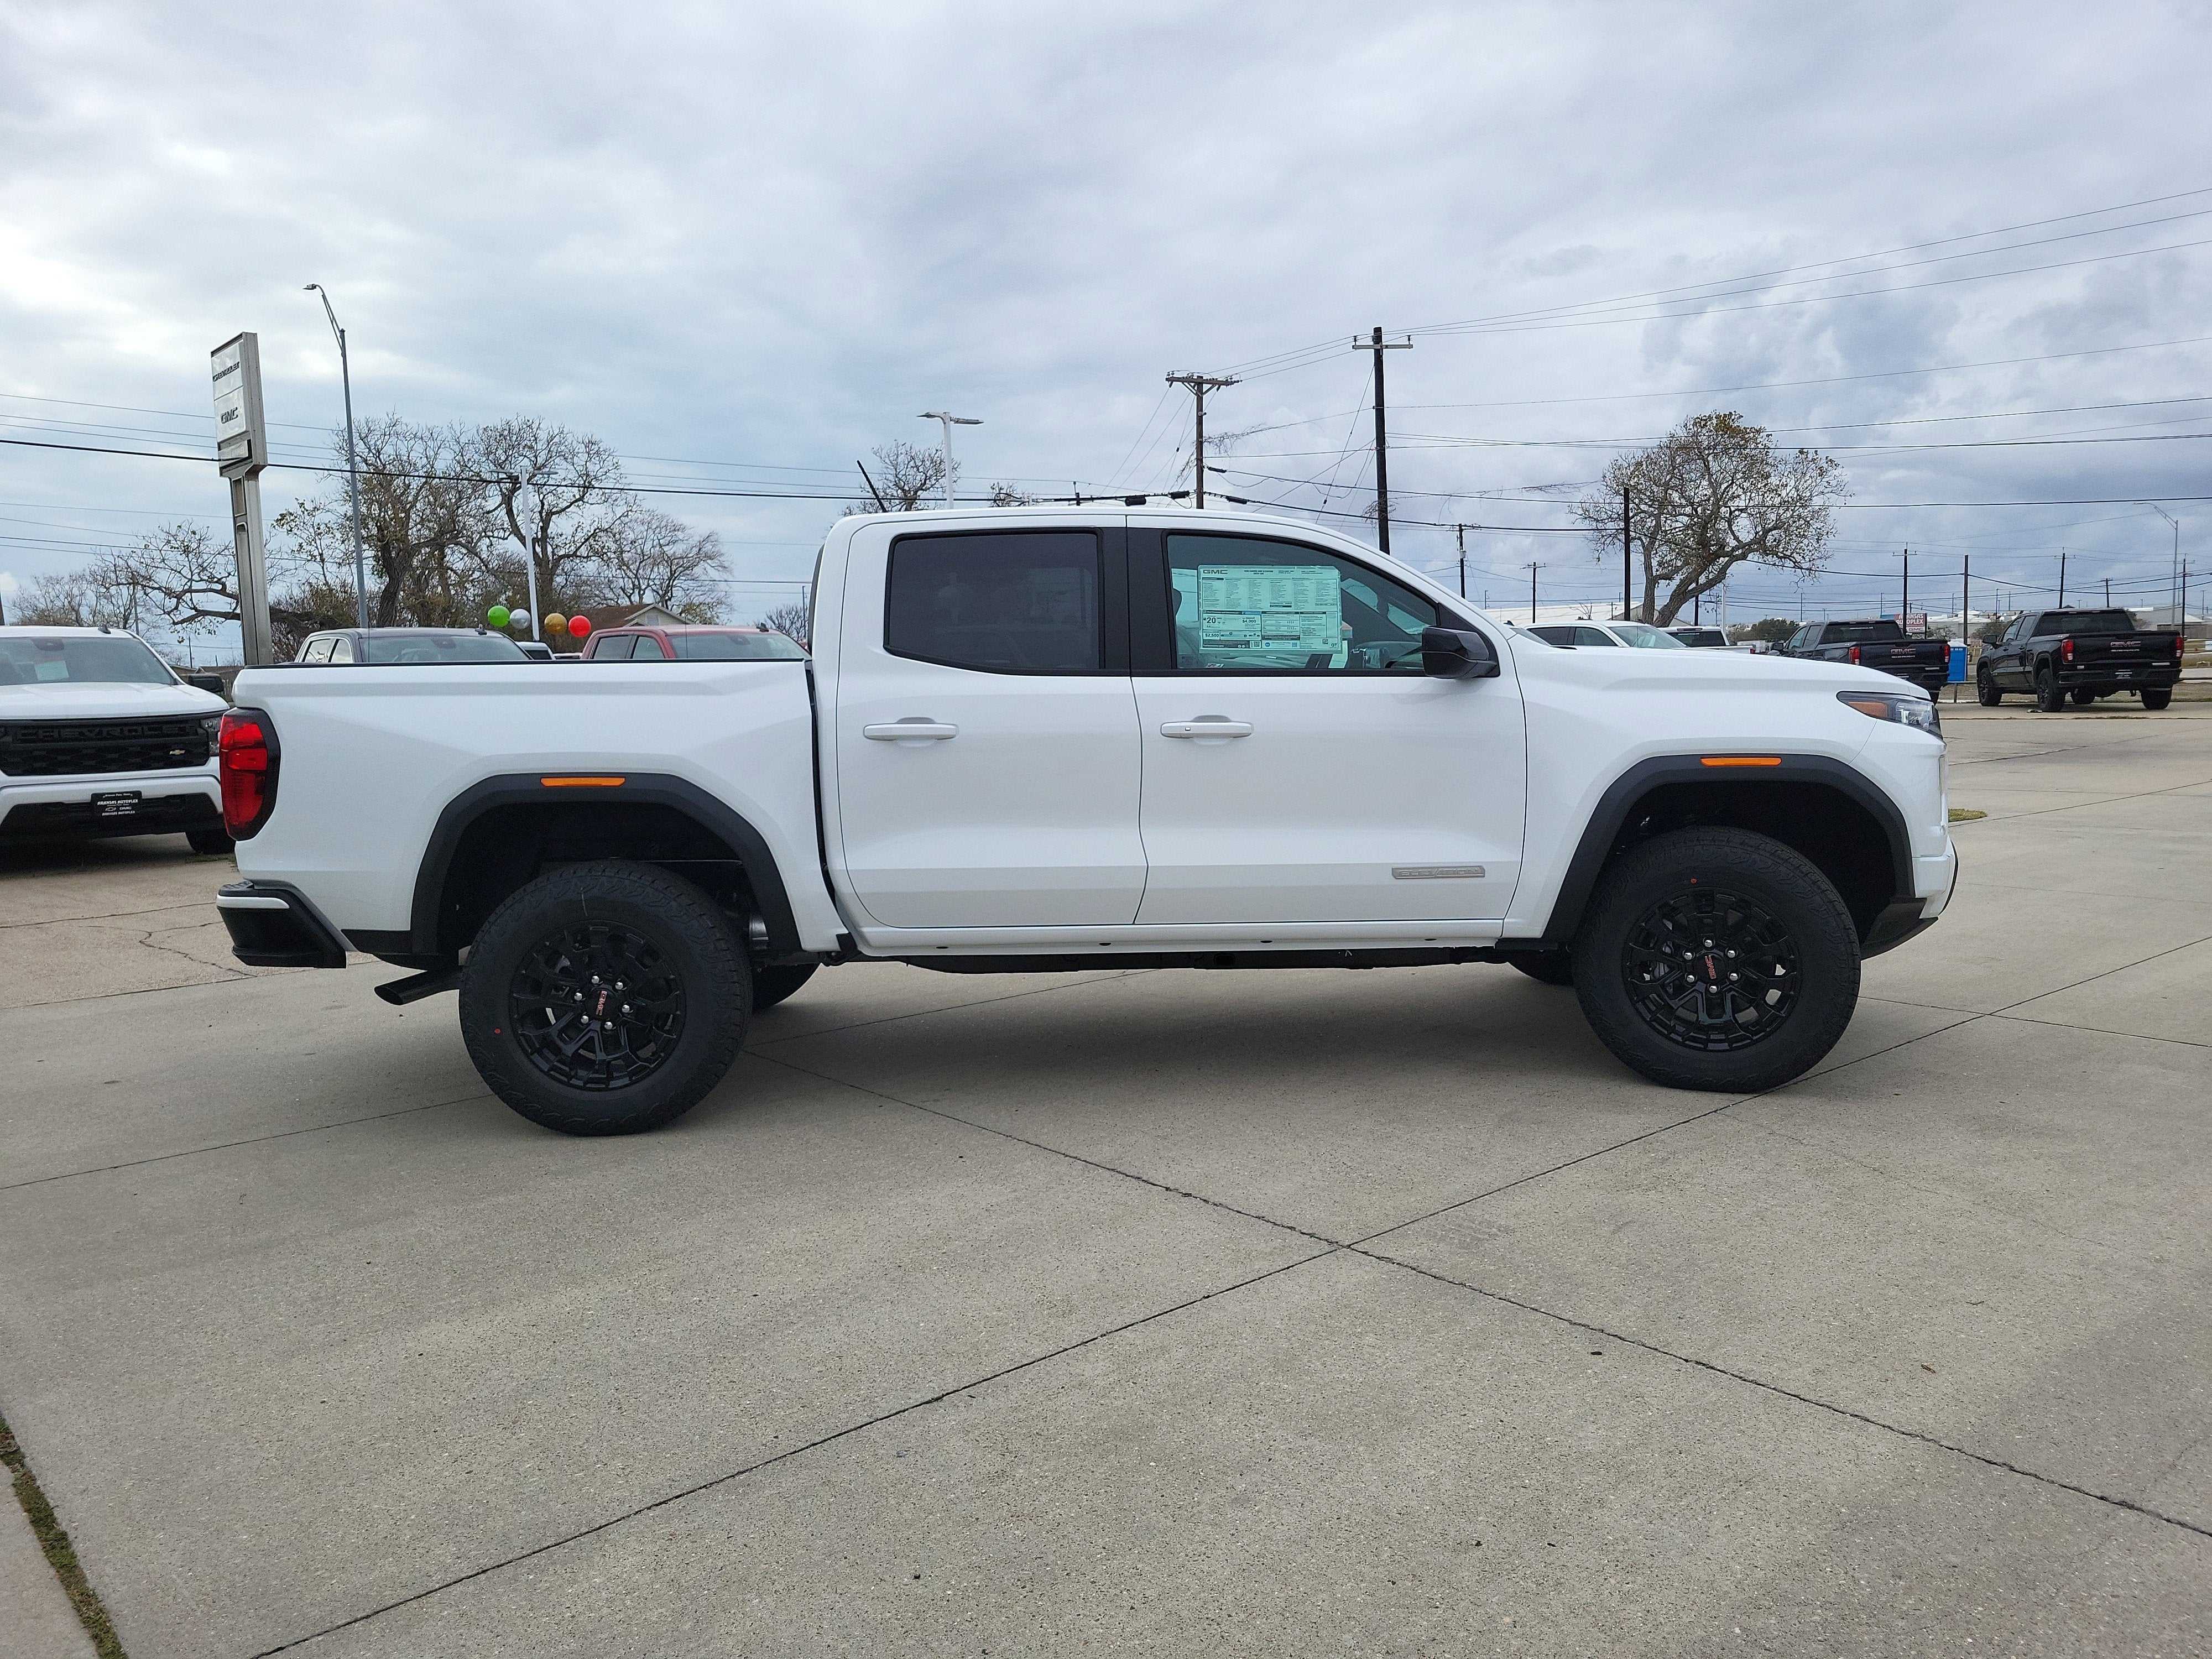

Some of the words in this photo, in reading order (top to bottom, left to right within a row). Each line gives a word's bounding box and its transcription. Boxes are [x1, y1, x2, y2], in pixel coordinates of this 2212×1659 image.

[213, 361, 240, 382] CHEVROLET
[221, 406, 238, 424] GMC
[1704, 955, 1717, 979] GMC
[596, 990, 607, 1015] GMC
